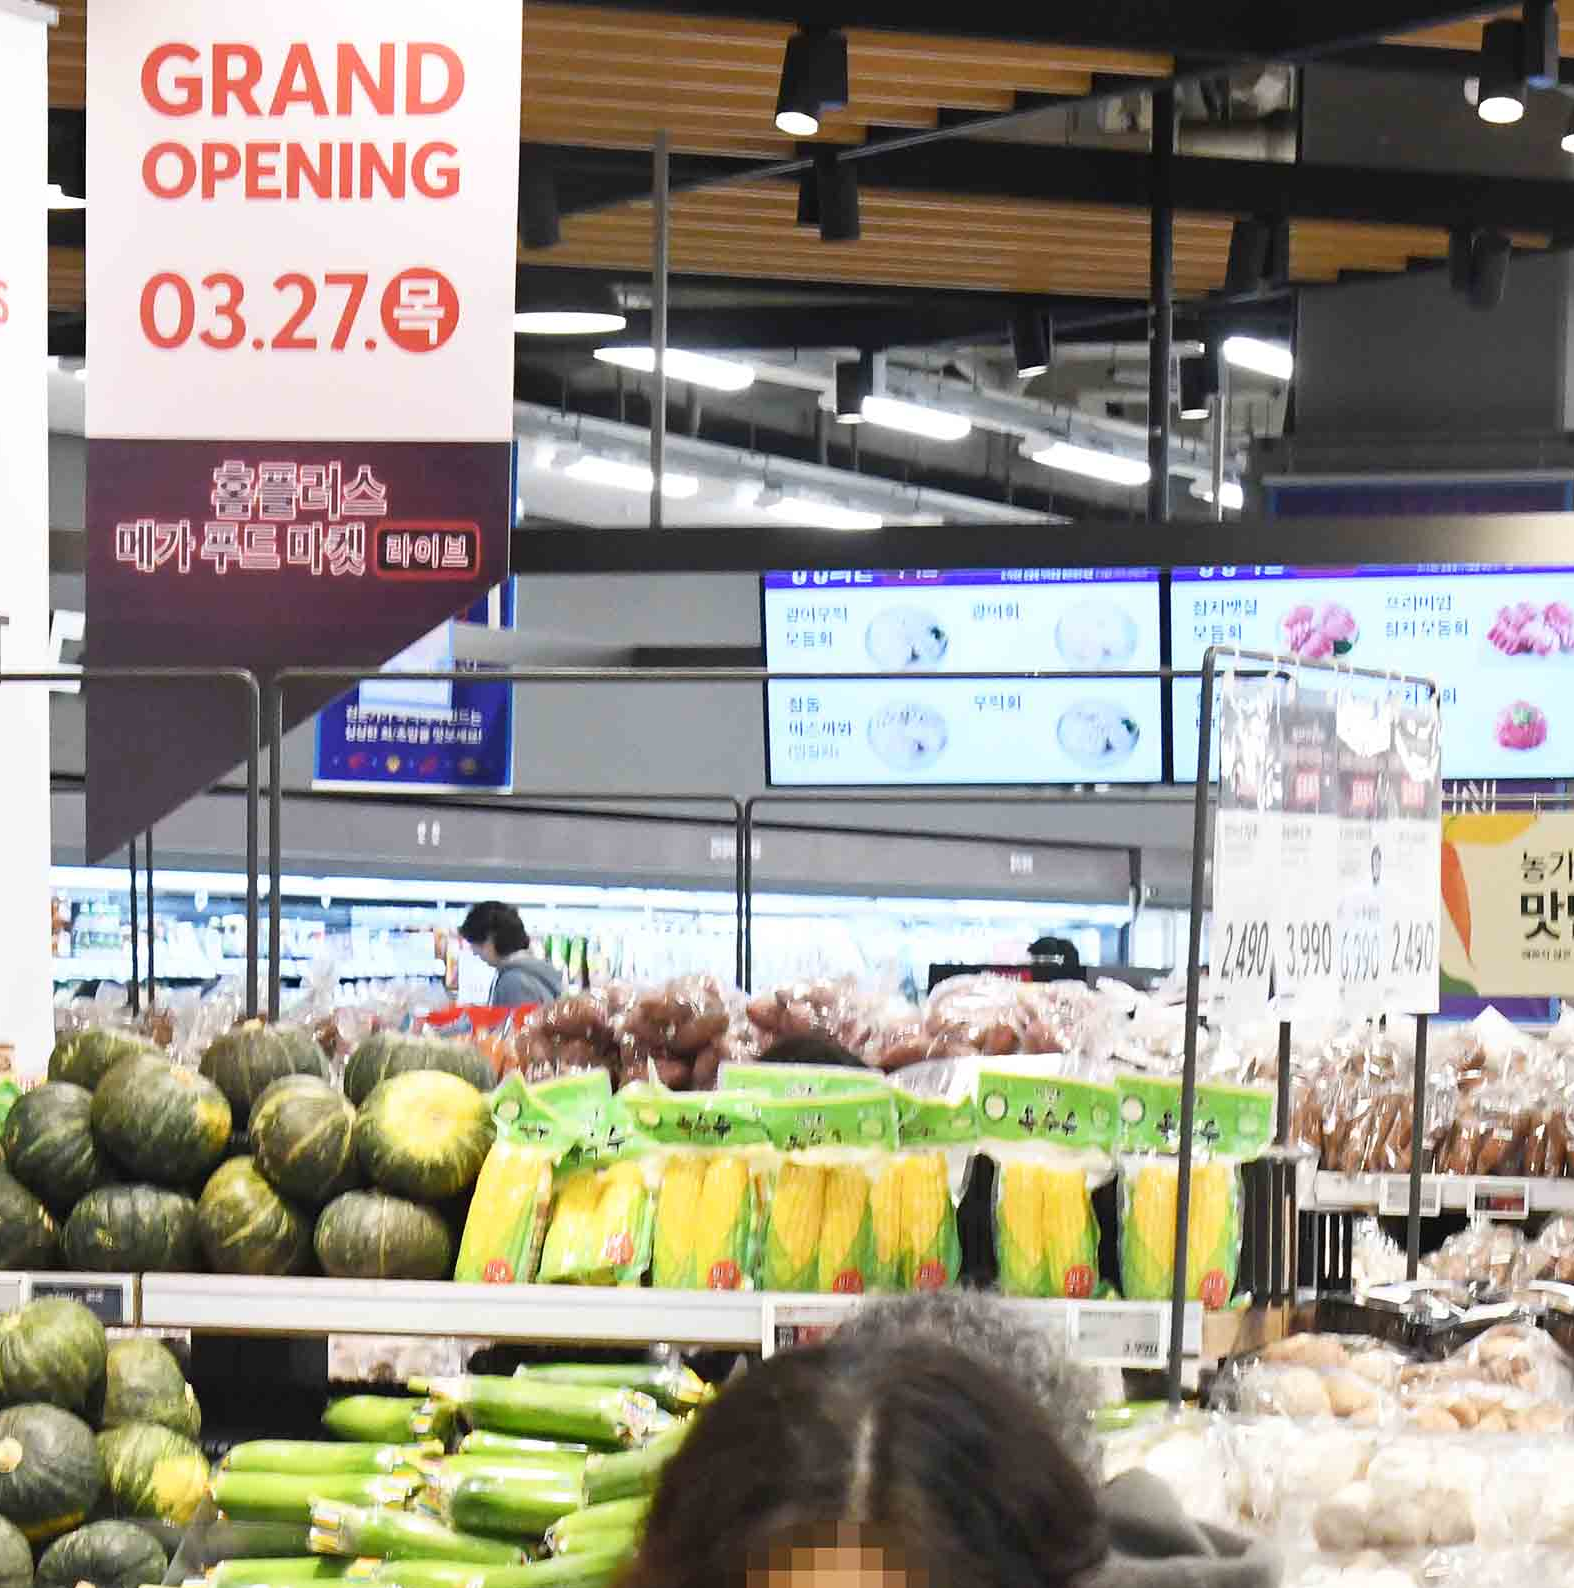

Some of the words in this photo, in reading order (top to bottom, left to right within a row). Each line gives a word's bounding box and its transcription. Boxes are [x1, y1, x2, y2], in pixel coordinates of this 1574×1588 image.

[140, 41, 466, 118] GRAND
[140, 141, 461, 201] OPENING
[210, 460, 389, 521] 홈플러스
[115, 521, 196, 573] 메가
[199, 521, 282, 573] 푸드
[286, 521, 367, 577] 마켓
[383, 532, 470, 570] 라이브
[1219, 920, 1270, 979] 2,490
[1286, 920, 1332, 980] 3,990
